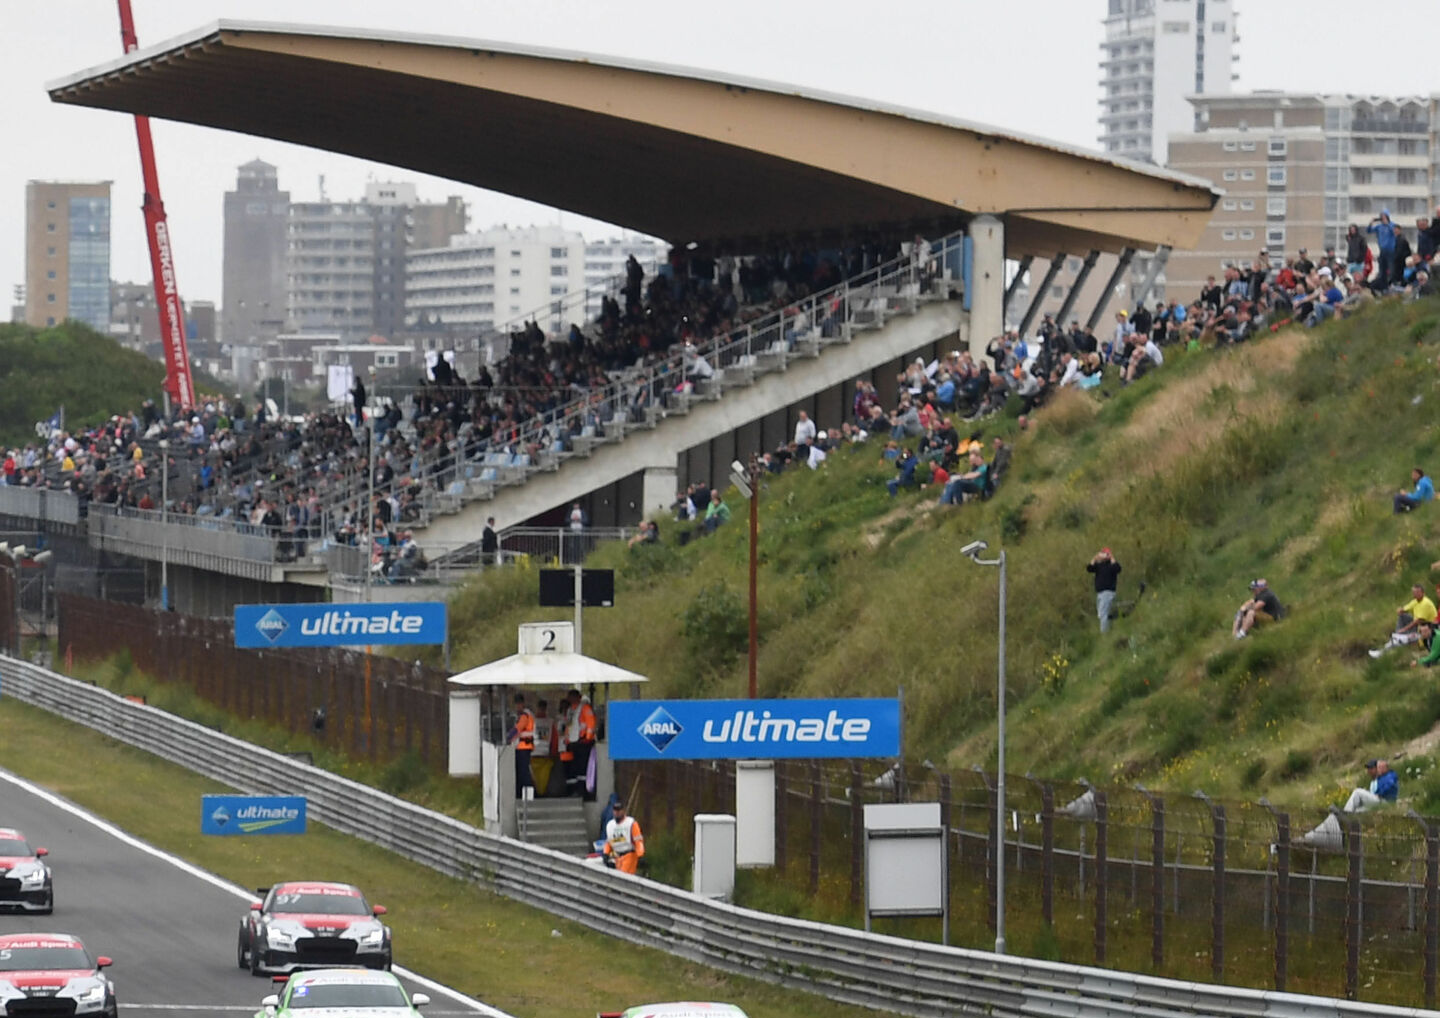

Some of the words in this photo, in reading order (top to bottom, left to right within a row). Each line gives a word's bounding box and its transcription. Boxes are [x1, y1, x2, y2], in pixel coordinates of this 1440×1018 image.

[301, 609, 424, 635] ultimate
[541, 630, 557, 651] 2
[643, 722, 677, 735] ARAL
[702, 710, 871, 742] ultimate
[237, 805, 299, 820] ultimate
[11, 941, 38, 949] Audi
[41, 941, 74, 949] Sport
